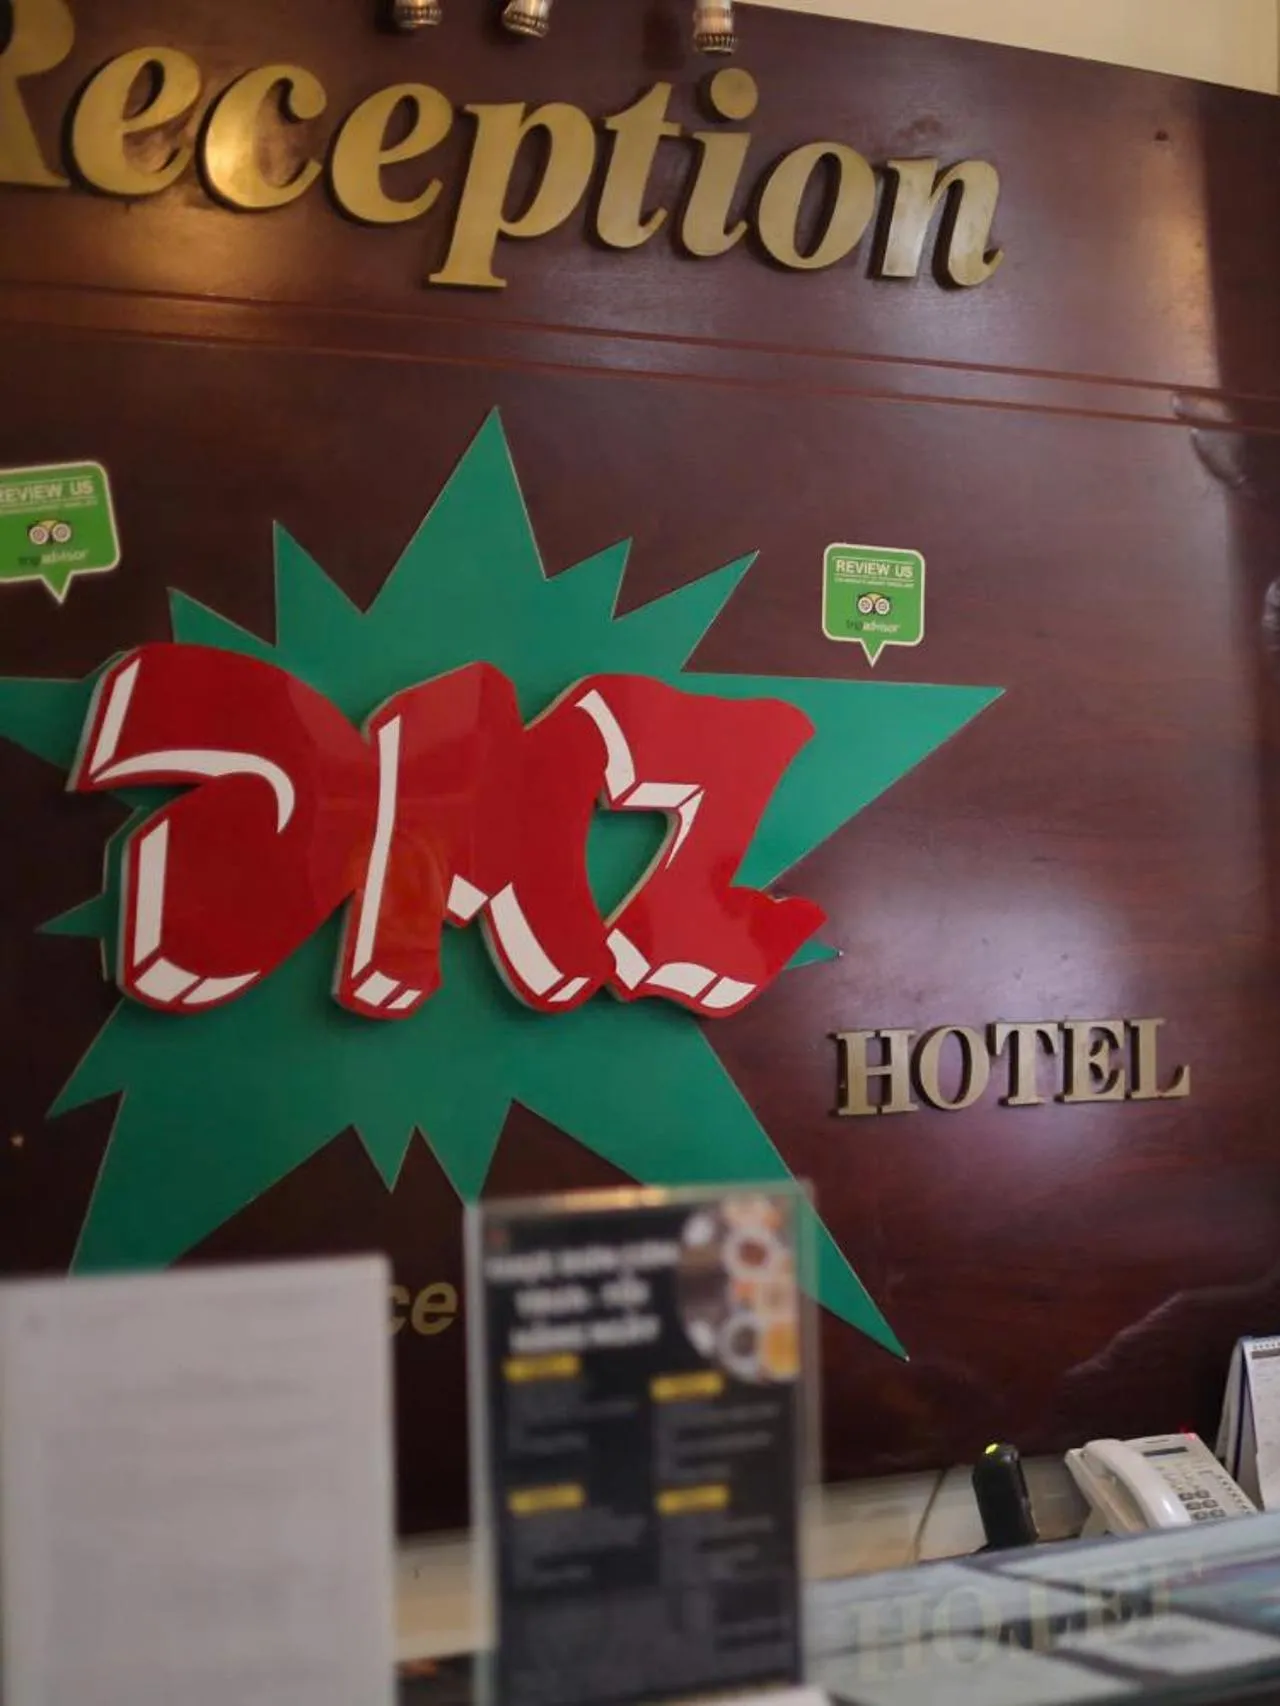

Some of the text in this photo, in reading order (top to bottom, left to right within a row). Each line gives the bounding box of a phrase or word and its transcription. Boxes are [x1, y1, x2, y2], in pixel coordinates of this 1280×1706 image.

[0, 479, 94, 503] EVIEW US
[835, 558, 914, 579] REVIEW US
[64, 641, 828, 1022] DMZ
[830, 1017, 1191, 1118] HOTEL
